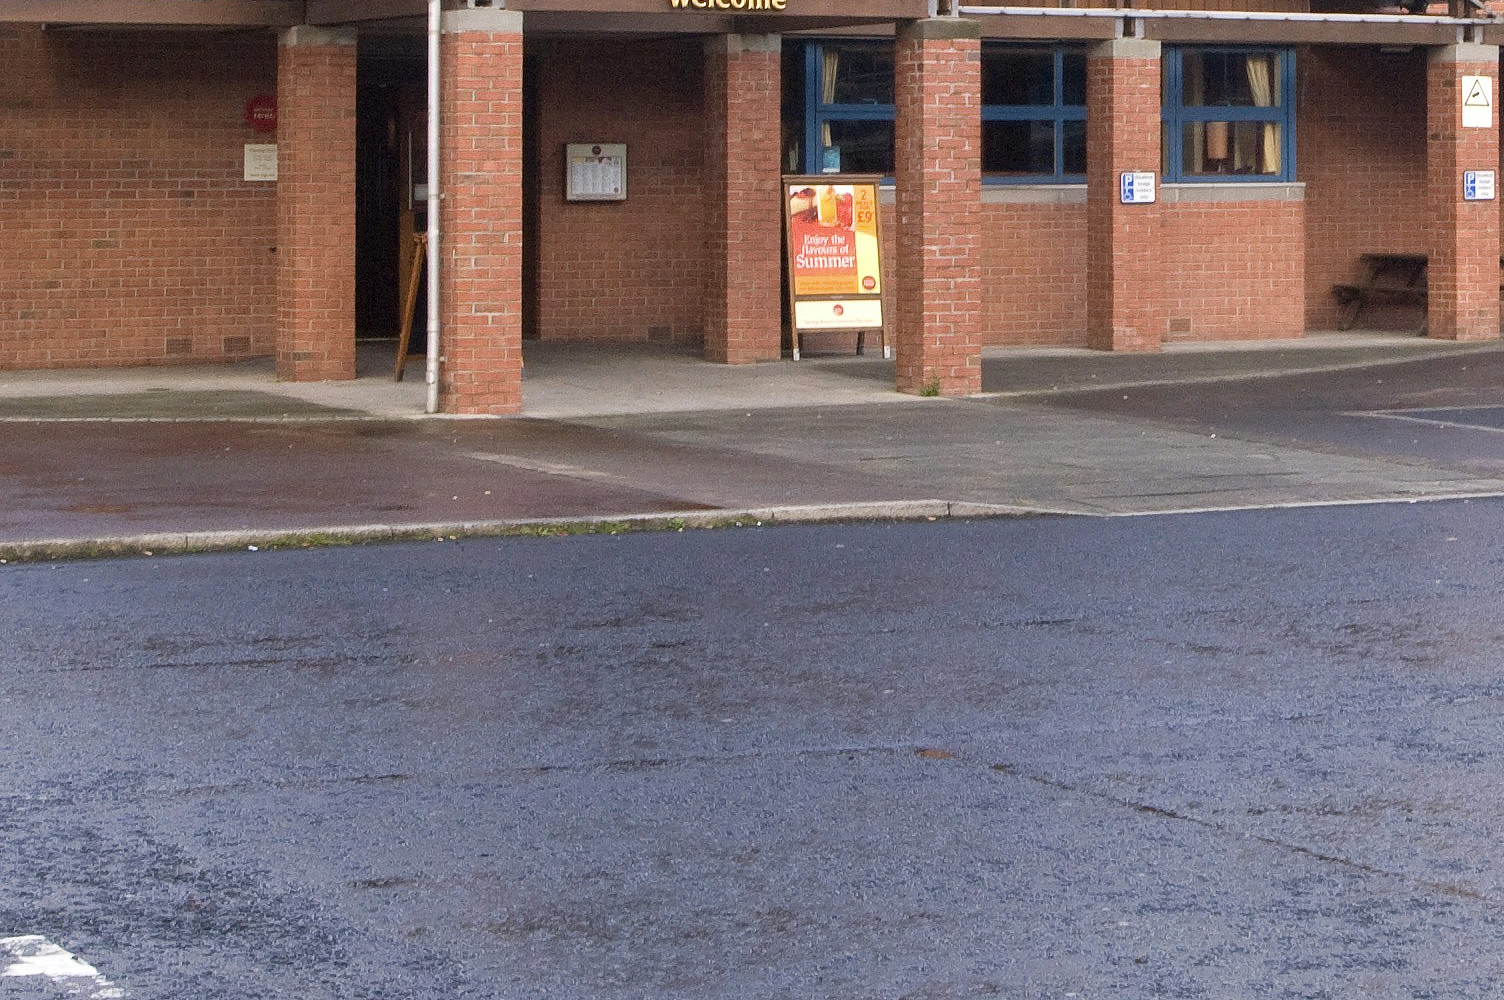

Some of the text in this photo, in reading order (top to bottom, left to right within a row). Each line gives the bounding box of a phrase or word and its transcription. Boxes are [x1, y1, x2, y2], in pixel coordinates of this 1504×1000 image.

[803, 234, 846, 246] Enjoy the
[839, 244, 849, 255] of
[796, 253, 855, 269] Summer
